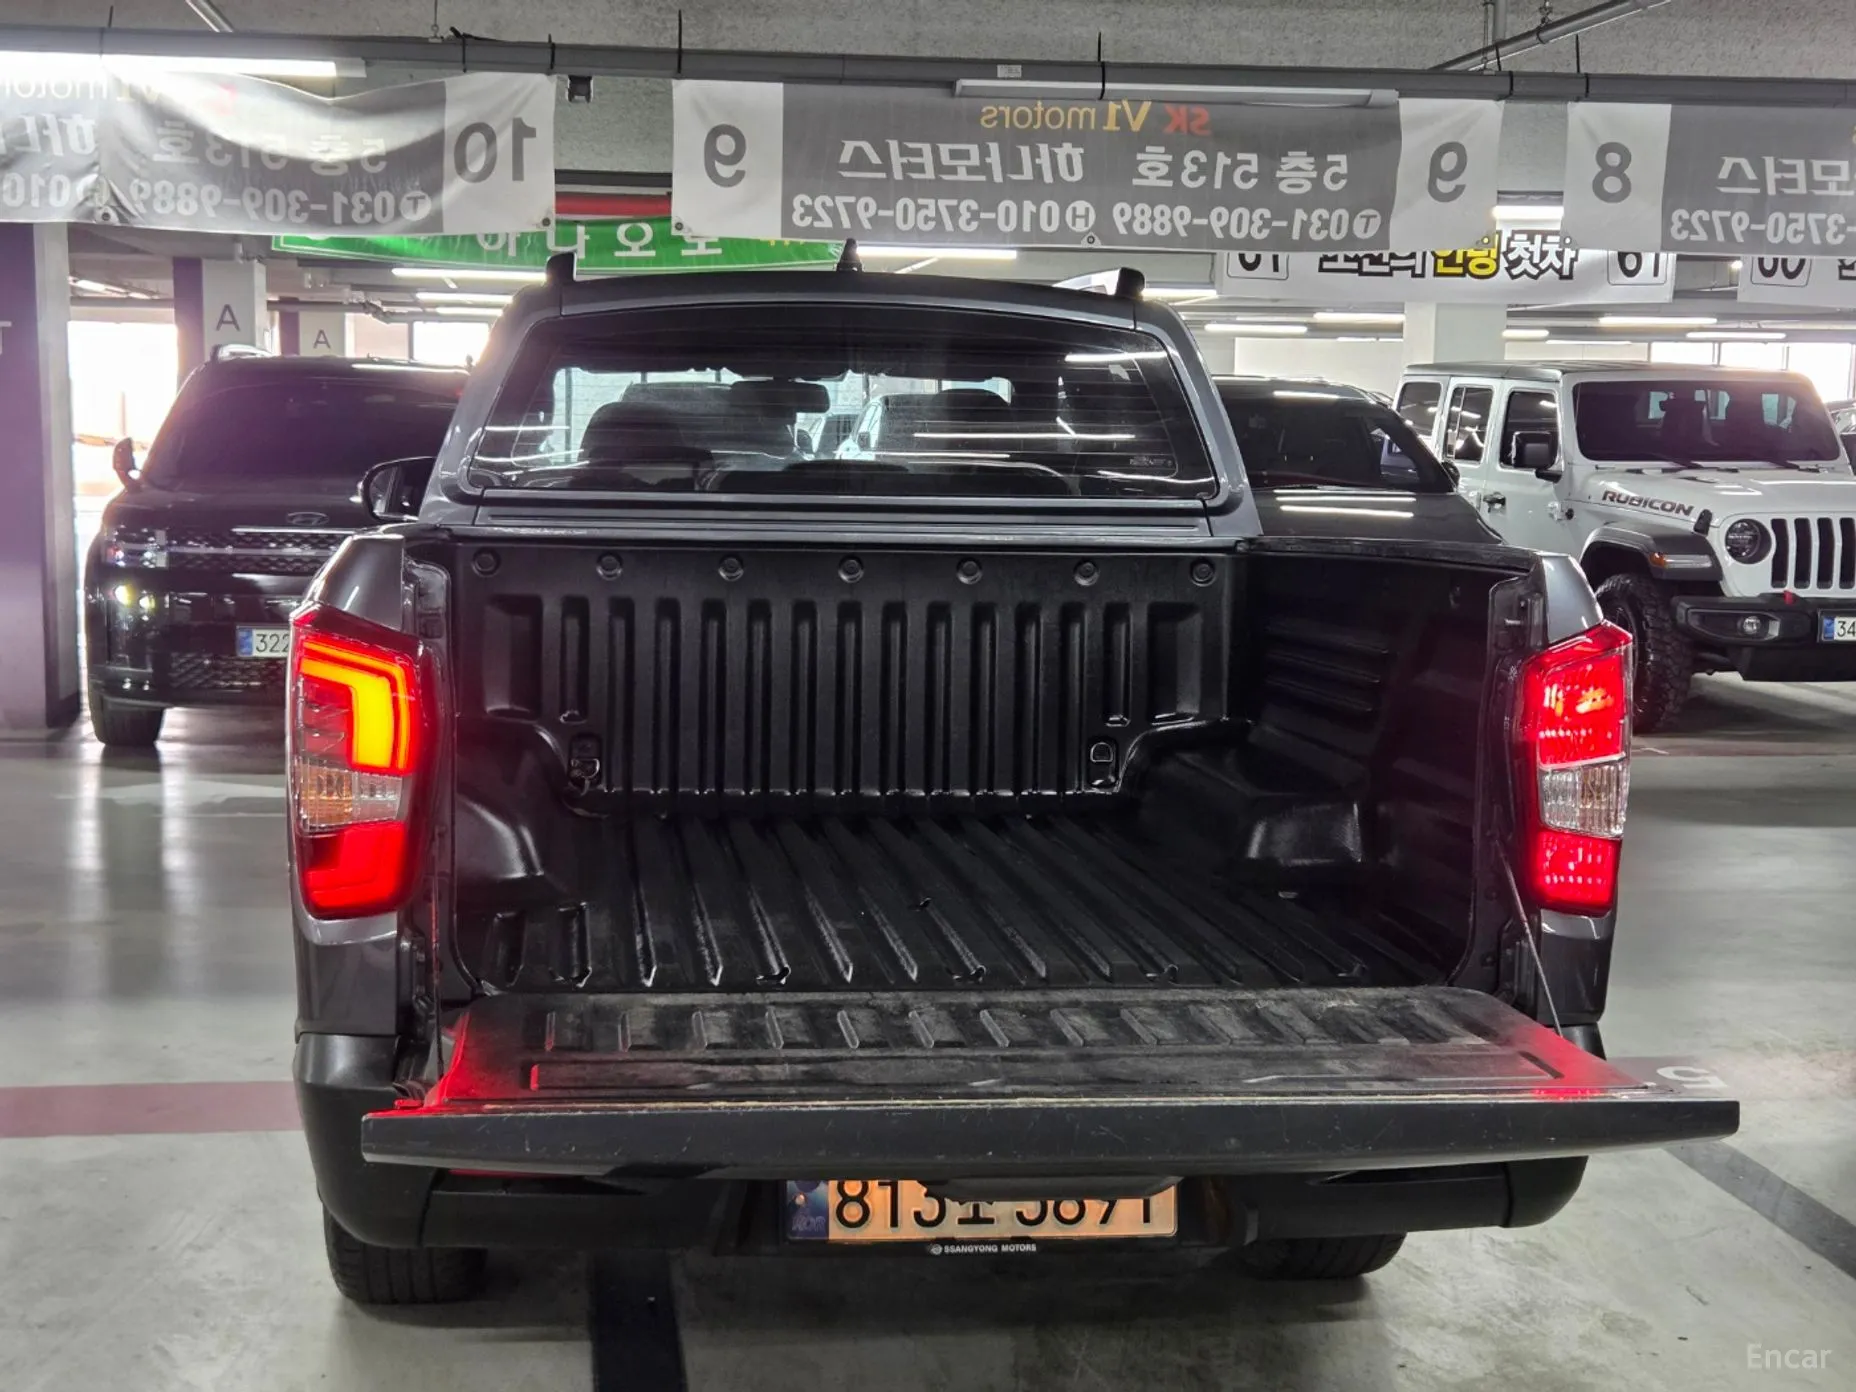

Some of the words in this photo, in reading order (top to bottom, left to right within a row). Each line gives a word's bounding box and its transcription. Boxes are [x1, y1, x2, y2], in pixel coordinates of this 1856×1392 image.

[215, 303, 241, 331] A
[312, 329, 331, 349] A
[1602, 490, 1694, 517] RUBICON
[944, 1243, 998, 1254] SSANGYONG
[1001, 1243, 1037, 1253] MOTORS
